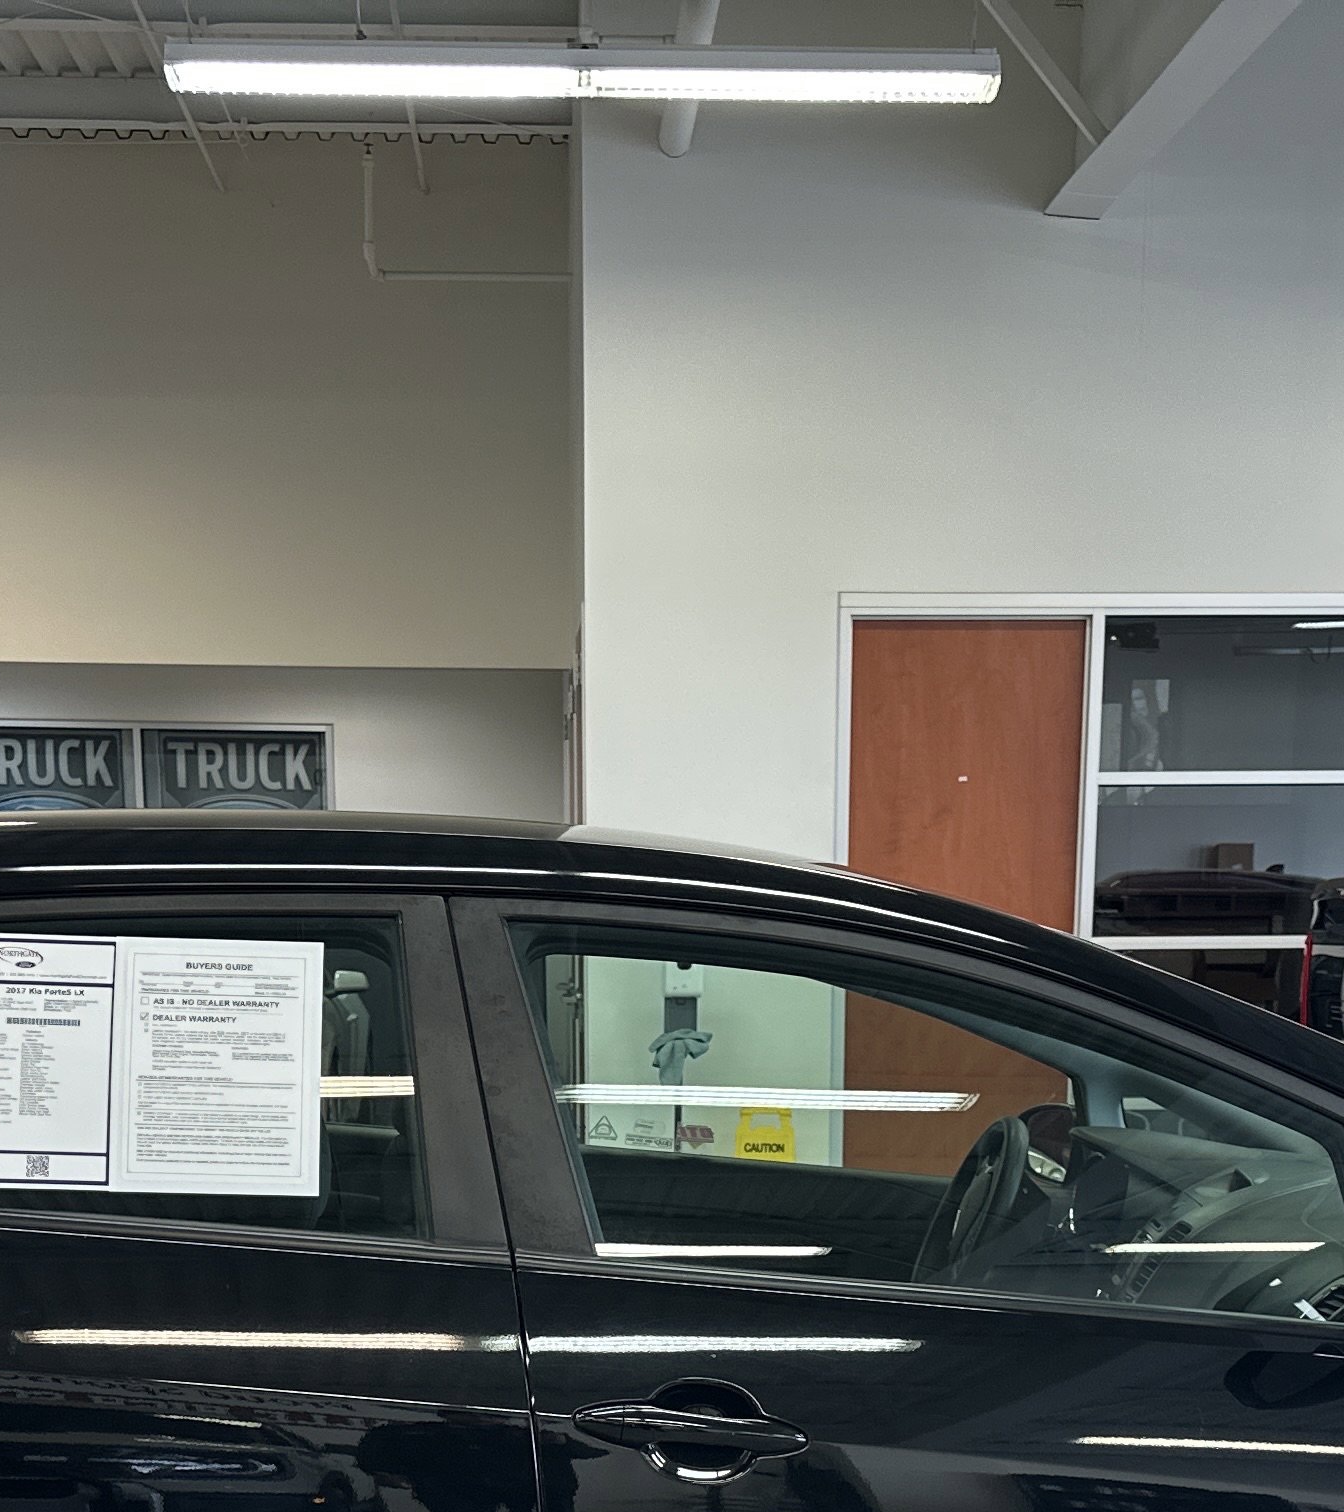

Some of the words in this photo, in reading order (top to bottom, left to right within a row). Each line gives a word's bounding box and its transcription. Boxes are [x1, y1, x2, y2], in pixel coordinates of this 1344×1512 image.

[166, 741, 314, 792] TRUCK
[185, 962, 223, 971] BUYERS
[225, 963, 254, 972] GUIDE
[5, 987, 26, 995] 2017
[29, 987, 42, 996] Kia
[196, 999, 230, 1007] DEALER
[232, 1000, 280, 1009] WARRANTY
[152, 1014, 187, 1022] DEALER
[189, 1015, 237, 1024] WARRANTY
[743, 1142, 785, 1153] CAUTION
